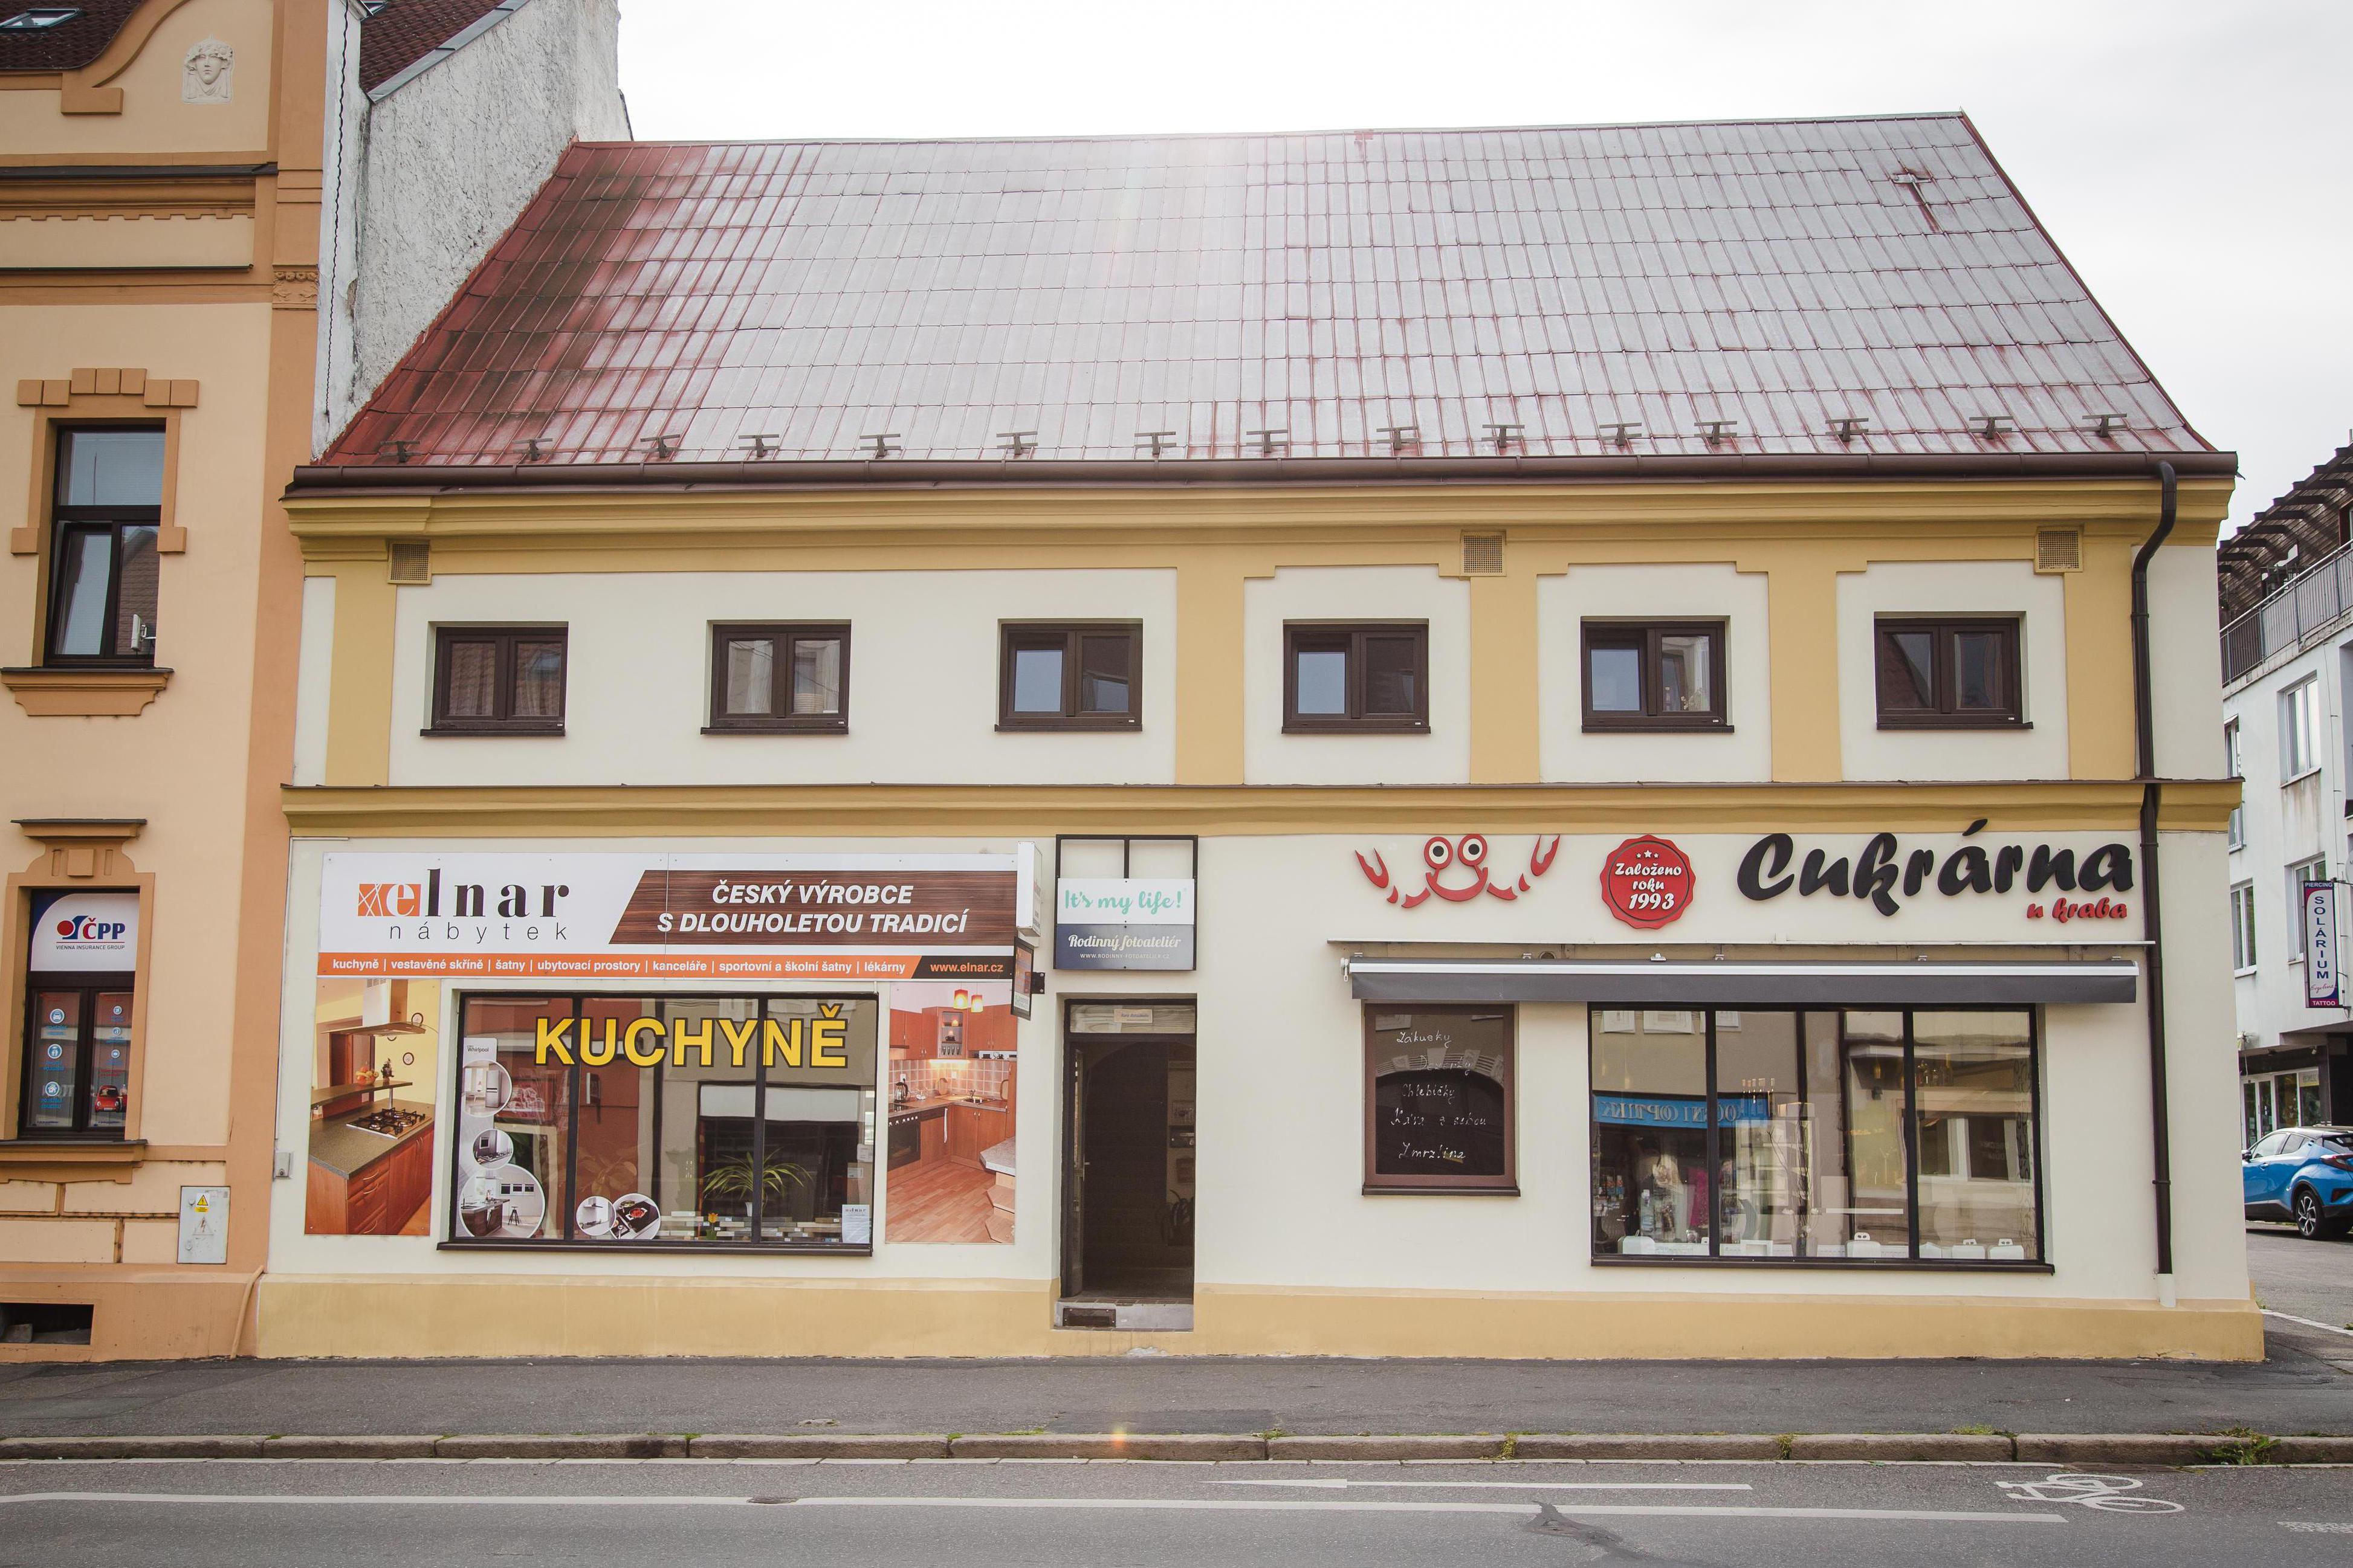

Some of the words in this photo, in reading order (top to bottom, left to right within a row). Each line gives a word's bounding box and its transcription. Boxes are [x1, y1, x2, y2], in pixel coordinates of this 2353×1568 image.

[1614, 863, 1682, 876] Založeno
[1736, 819, 2135, 917] Cukrárna
[386, 868, 569, 918] elnar
[712, 880, 794, 904] ČESKÝ
[799, 880, 914, 904] VÝROBCE
[1633, 878, 1665, 892] roku
[1064, 889, 1093, 909] It's
[1098, 897, 1133, 915] my
[1628, 893, 1675, 910] 1993
[2026, 903, 2044, 918] u
[2052, 897, 2127, 923] kraba
[82, 918, 126, 940] ČPP
[390, 921, 567, 944] nábytek
[657, 913, 673, 933] S
[679, 913, 863, 934] DLOUHOLETOU
[870, 909, 970, 934] TRADICÍ
[1068, 934, 1120, 951] Rodinný
[1119, 935, 1182, 951] fotoateliér
[2314, 896, 2329, 979] SOLÁRIUM
[332, 959, 380, 971] kuchyně
[391, 959, 447, 970] vestavěné
[449, 960, 484, 970] skříně
[495, 960, 526, 972] šatny
[538, 960, 591, 972] ubytovací
[594, 961, 641, 973] prostory
[653, 961, 707, 971] kanceláře
[719, 961, 772, 973] sportovní
[775, 963, 782, 972] a
[785, 961, 819, 972] školní
[821, 961, 852, 974] šatny
[864, 961, 906, 974] lékárny
[930, 962, 1004, 972] www.elnar.cz
[534, 1003, 848, 1068] KUCHYNĚ
[1396, 1030, 1451, 1048] Zákusky
